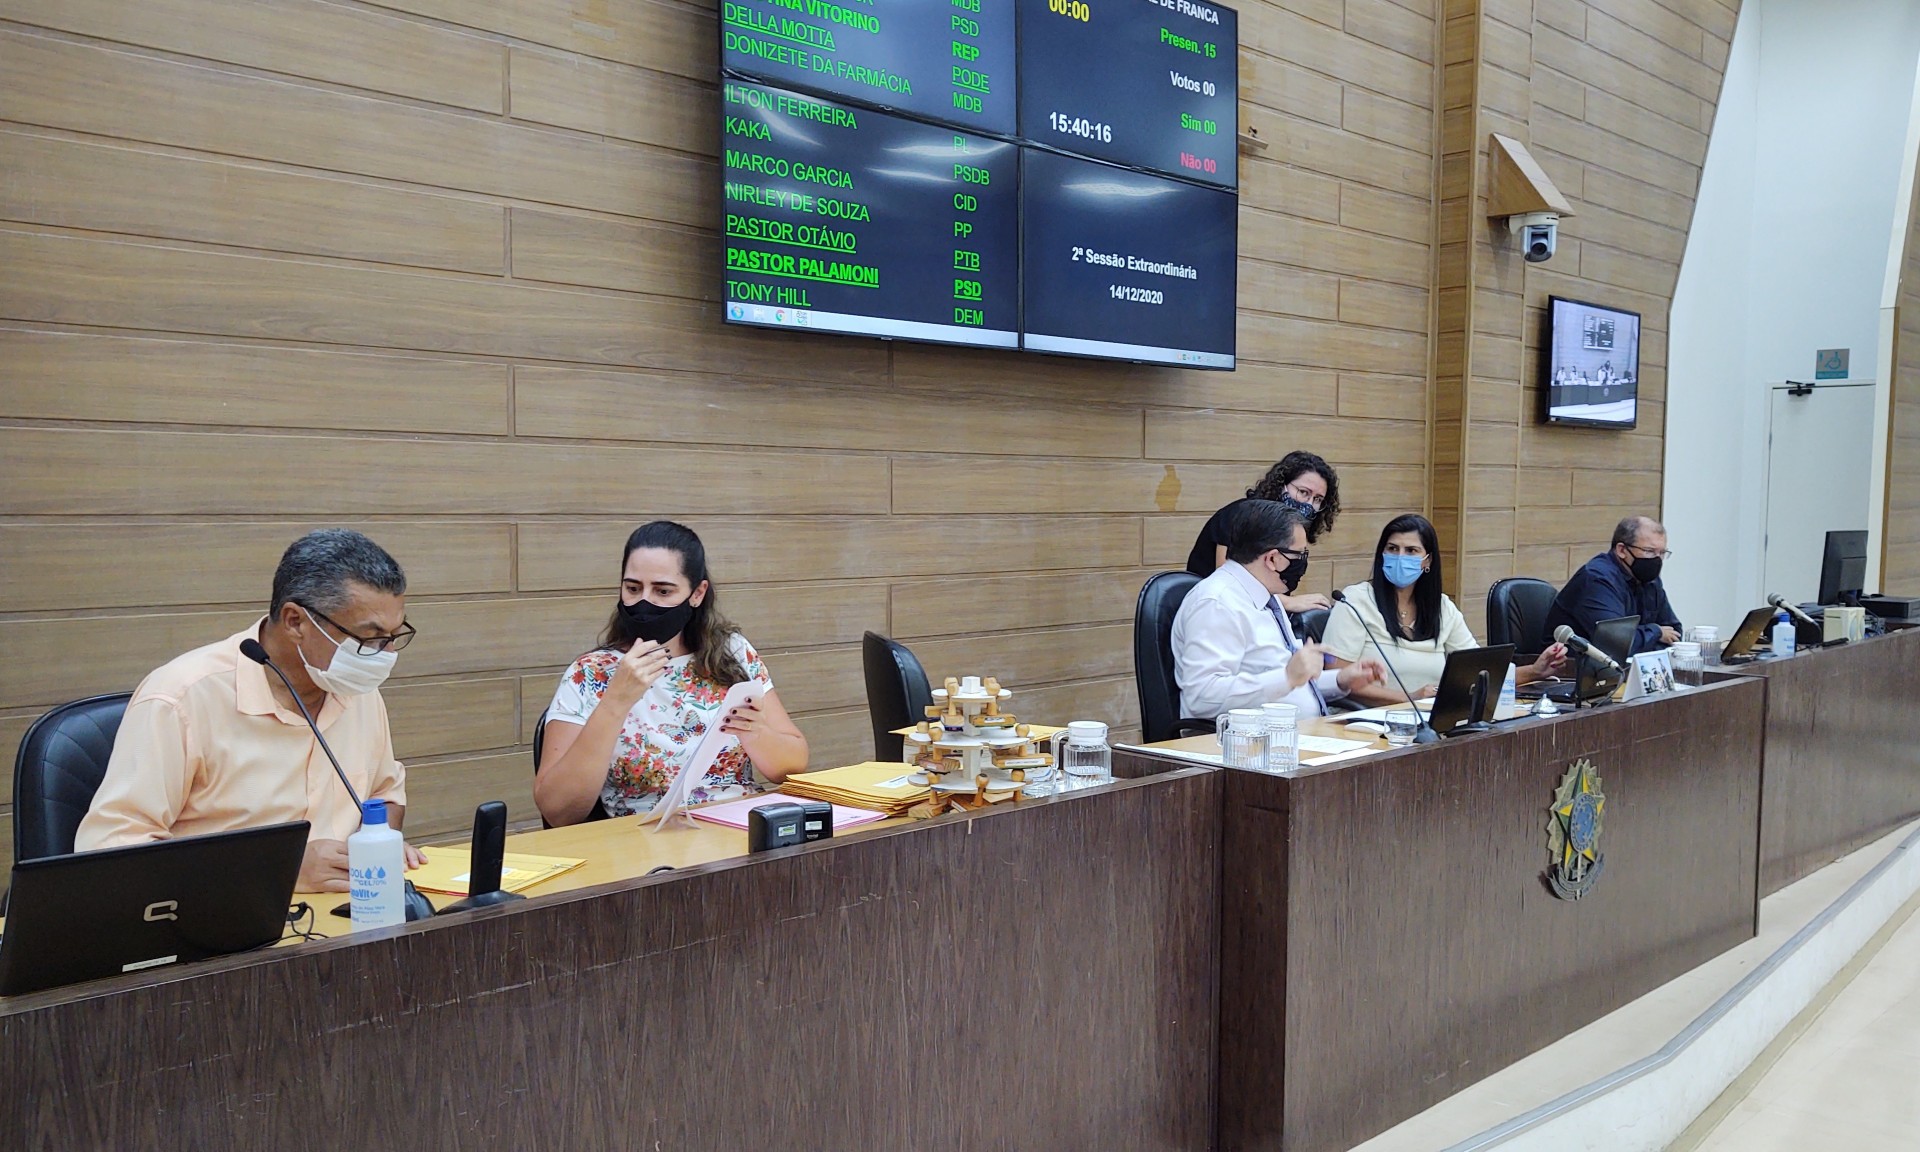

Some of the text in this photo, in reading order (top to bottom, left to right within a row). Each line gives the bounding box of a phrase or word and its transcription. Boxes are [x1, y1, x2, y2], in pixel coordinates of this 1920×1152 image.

[805, 0, 880, 34] VITORINO
[1049, 0, 1089, 22] 00:00
[1177, 0, 1219, 25] FRANCA
[724, 2, 835, 48] DELLA MOTTA
[952, 15, 979, 36] PSD
[953, 41, 980, 61] REP
[1160, 28, 1216, 58] Presen. 15
[725, 32, 912, 95] DONIZETE DA FARMÁCIA
[952, 66, 989, 89] PODE
[1170, 70, 1215, 96] Votos 00
[725, 85, 857, 130] ILTON FERREIRA
[953, 92, 982, 113] MDB
[726, 116, 771, 141] KAKA
[1050, 112, 1112, 143] 15:40:16
[1181, 112, 1216, 135] Sim 00
[954, 135, 970, 153] PL
[726, 150, 853, 189] MARCO GARCIA
[954, 164, 989, 184] PSDB
[1180, 152, 1216, 174] Não 00
[726, 182, 870, 222] NIRLEY DE SOUZA
[954, 194, 977, 212] CID
[727, 215, 856, 250] PASTOR OTÁVIO
[954, 222, 972, 238] PP
[727, 248, 878, 284] PASTOR PALAMONI
[954, 250, 980, 268] PTB
[1072, 246, 1197, 280] 2ª Sessão Extraordinária
[727, 281, 811, 306] TONY HILL
[954, 280, 981, 297] PSD
[1110, 284, 1163, 304] 14/12/2020
[954, 308, 983, 326] DEM
